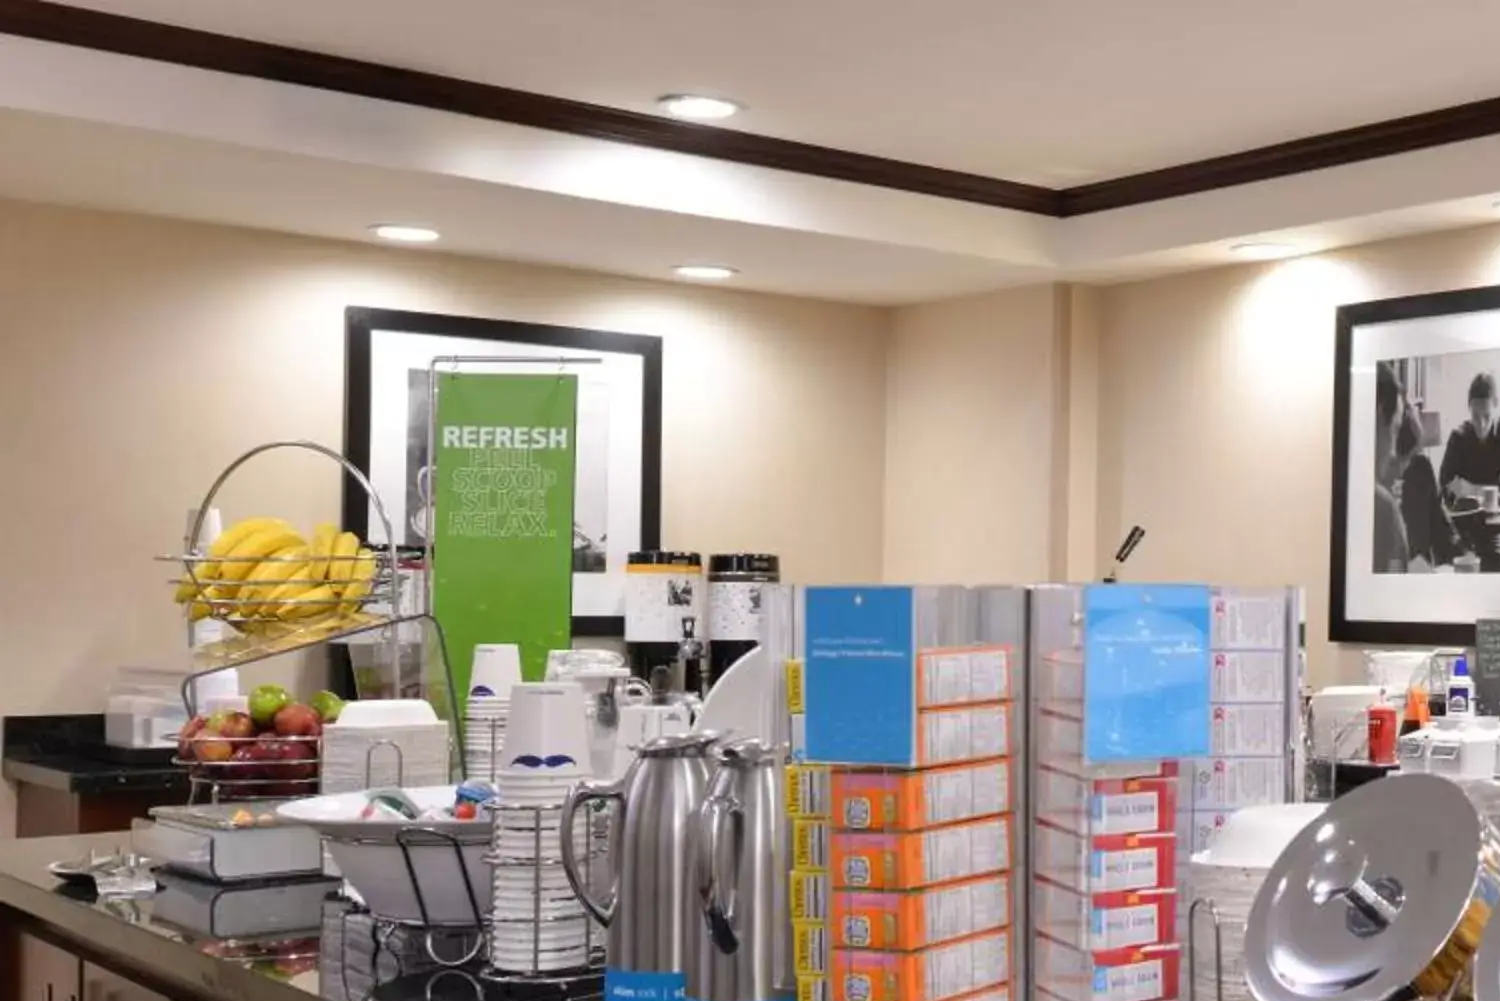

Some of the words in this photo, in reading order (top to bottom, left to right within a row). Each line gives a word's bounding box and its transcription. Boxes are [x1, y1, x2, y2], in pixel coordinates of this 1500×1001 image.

[443, 425, 568, 449] REFRESH
[452, 466, 557, 493] SCOOP
[461, 490, 546, 515] SLICE
[448, 511, 557, 537] RELAX.
